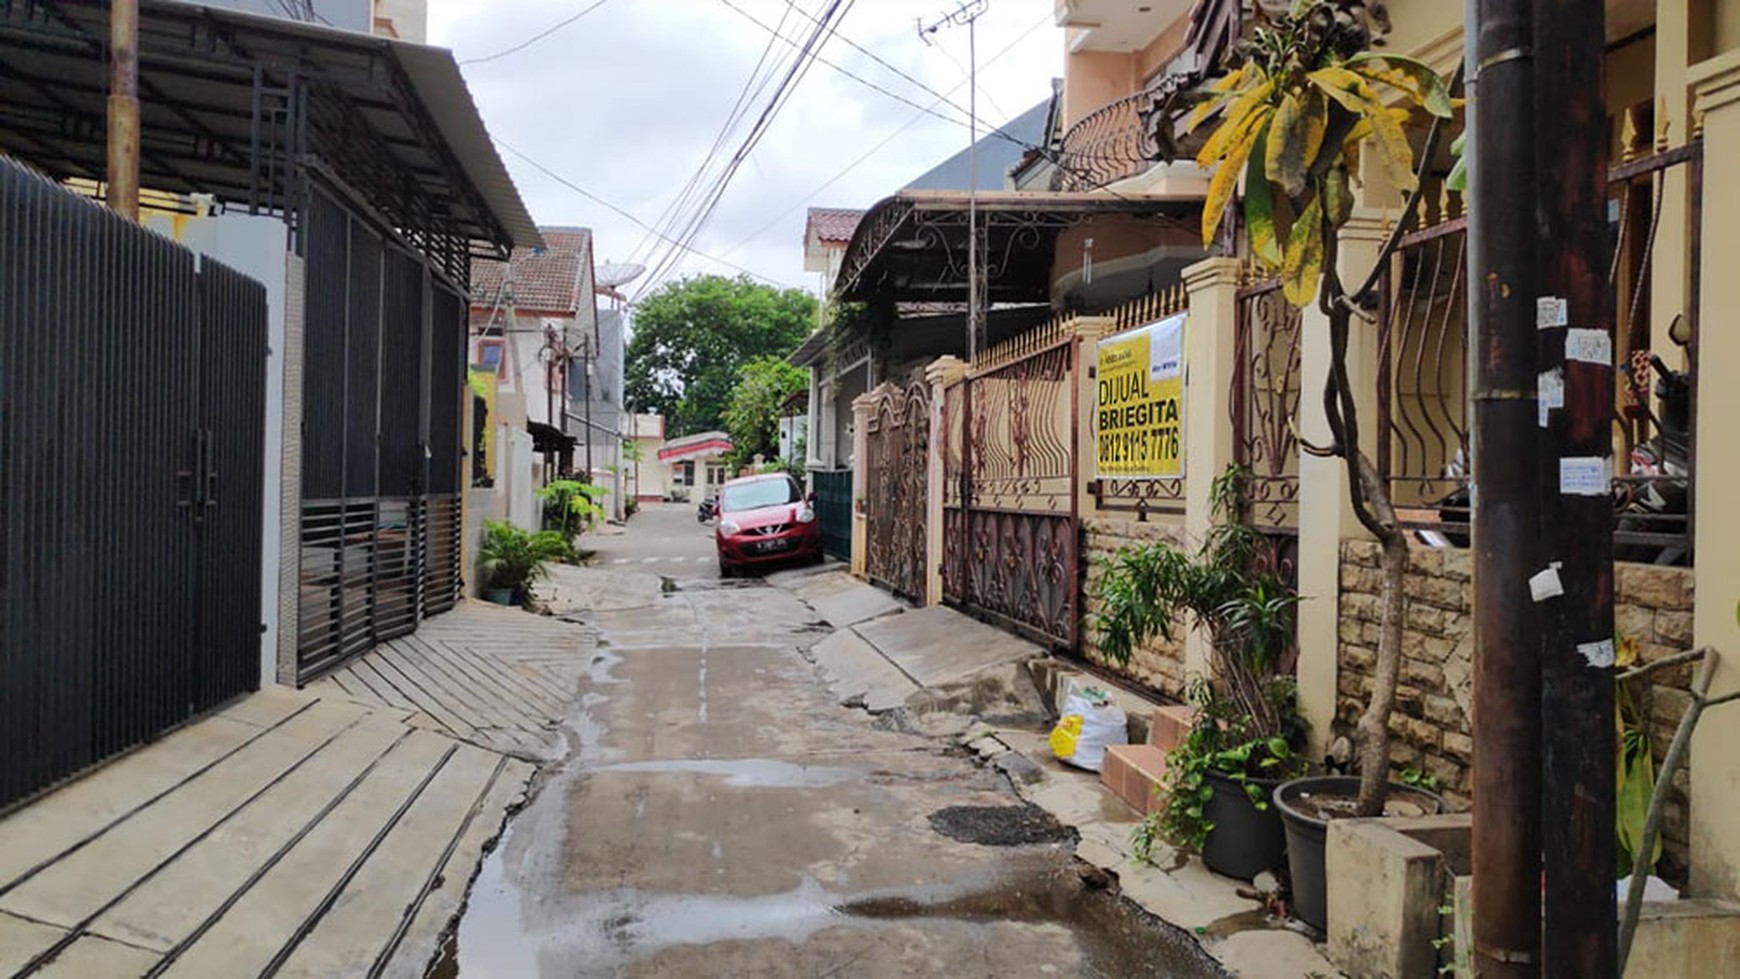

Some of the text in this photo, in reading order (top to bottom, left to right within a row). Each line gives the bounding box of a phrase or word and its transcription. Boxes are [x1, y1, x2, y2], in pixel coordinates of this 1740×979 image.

[1099, 369, 1149, 406] DIJUAL
[1100, 398, 1178, 431] BRIEGITA
[1123, 430, 1148, 461] 9115
[1151, 426, 1179, 459] 7776
